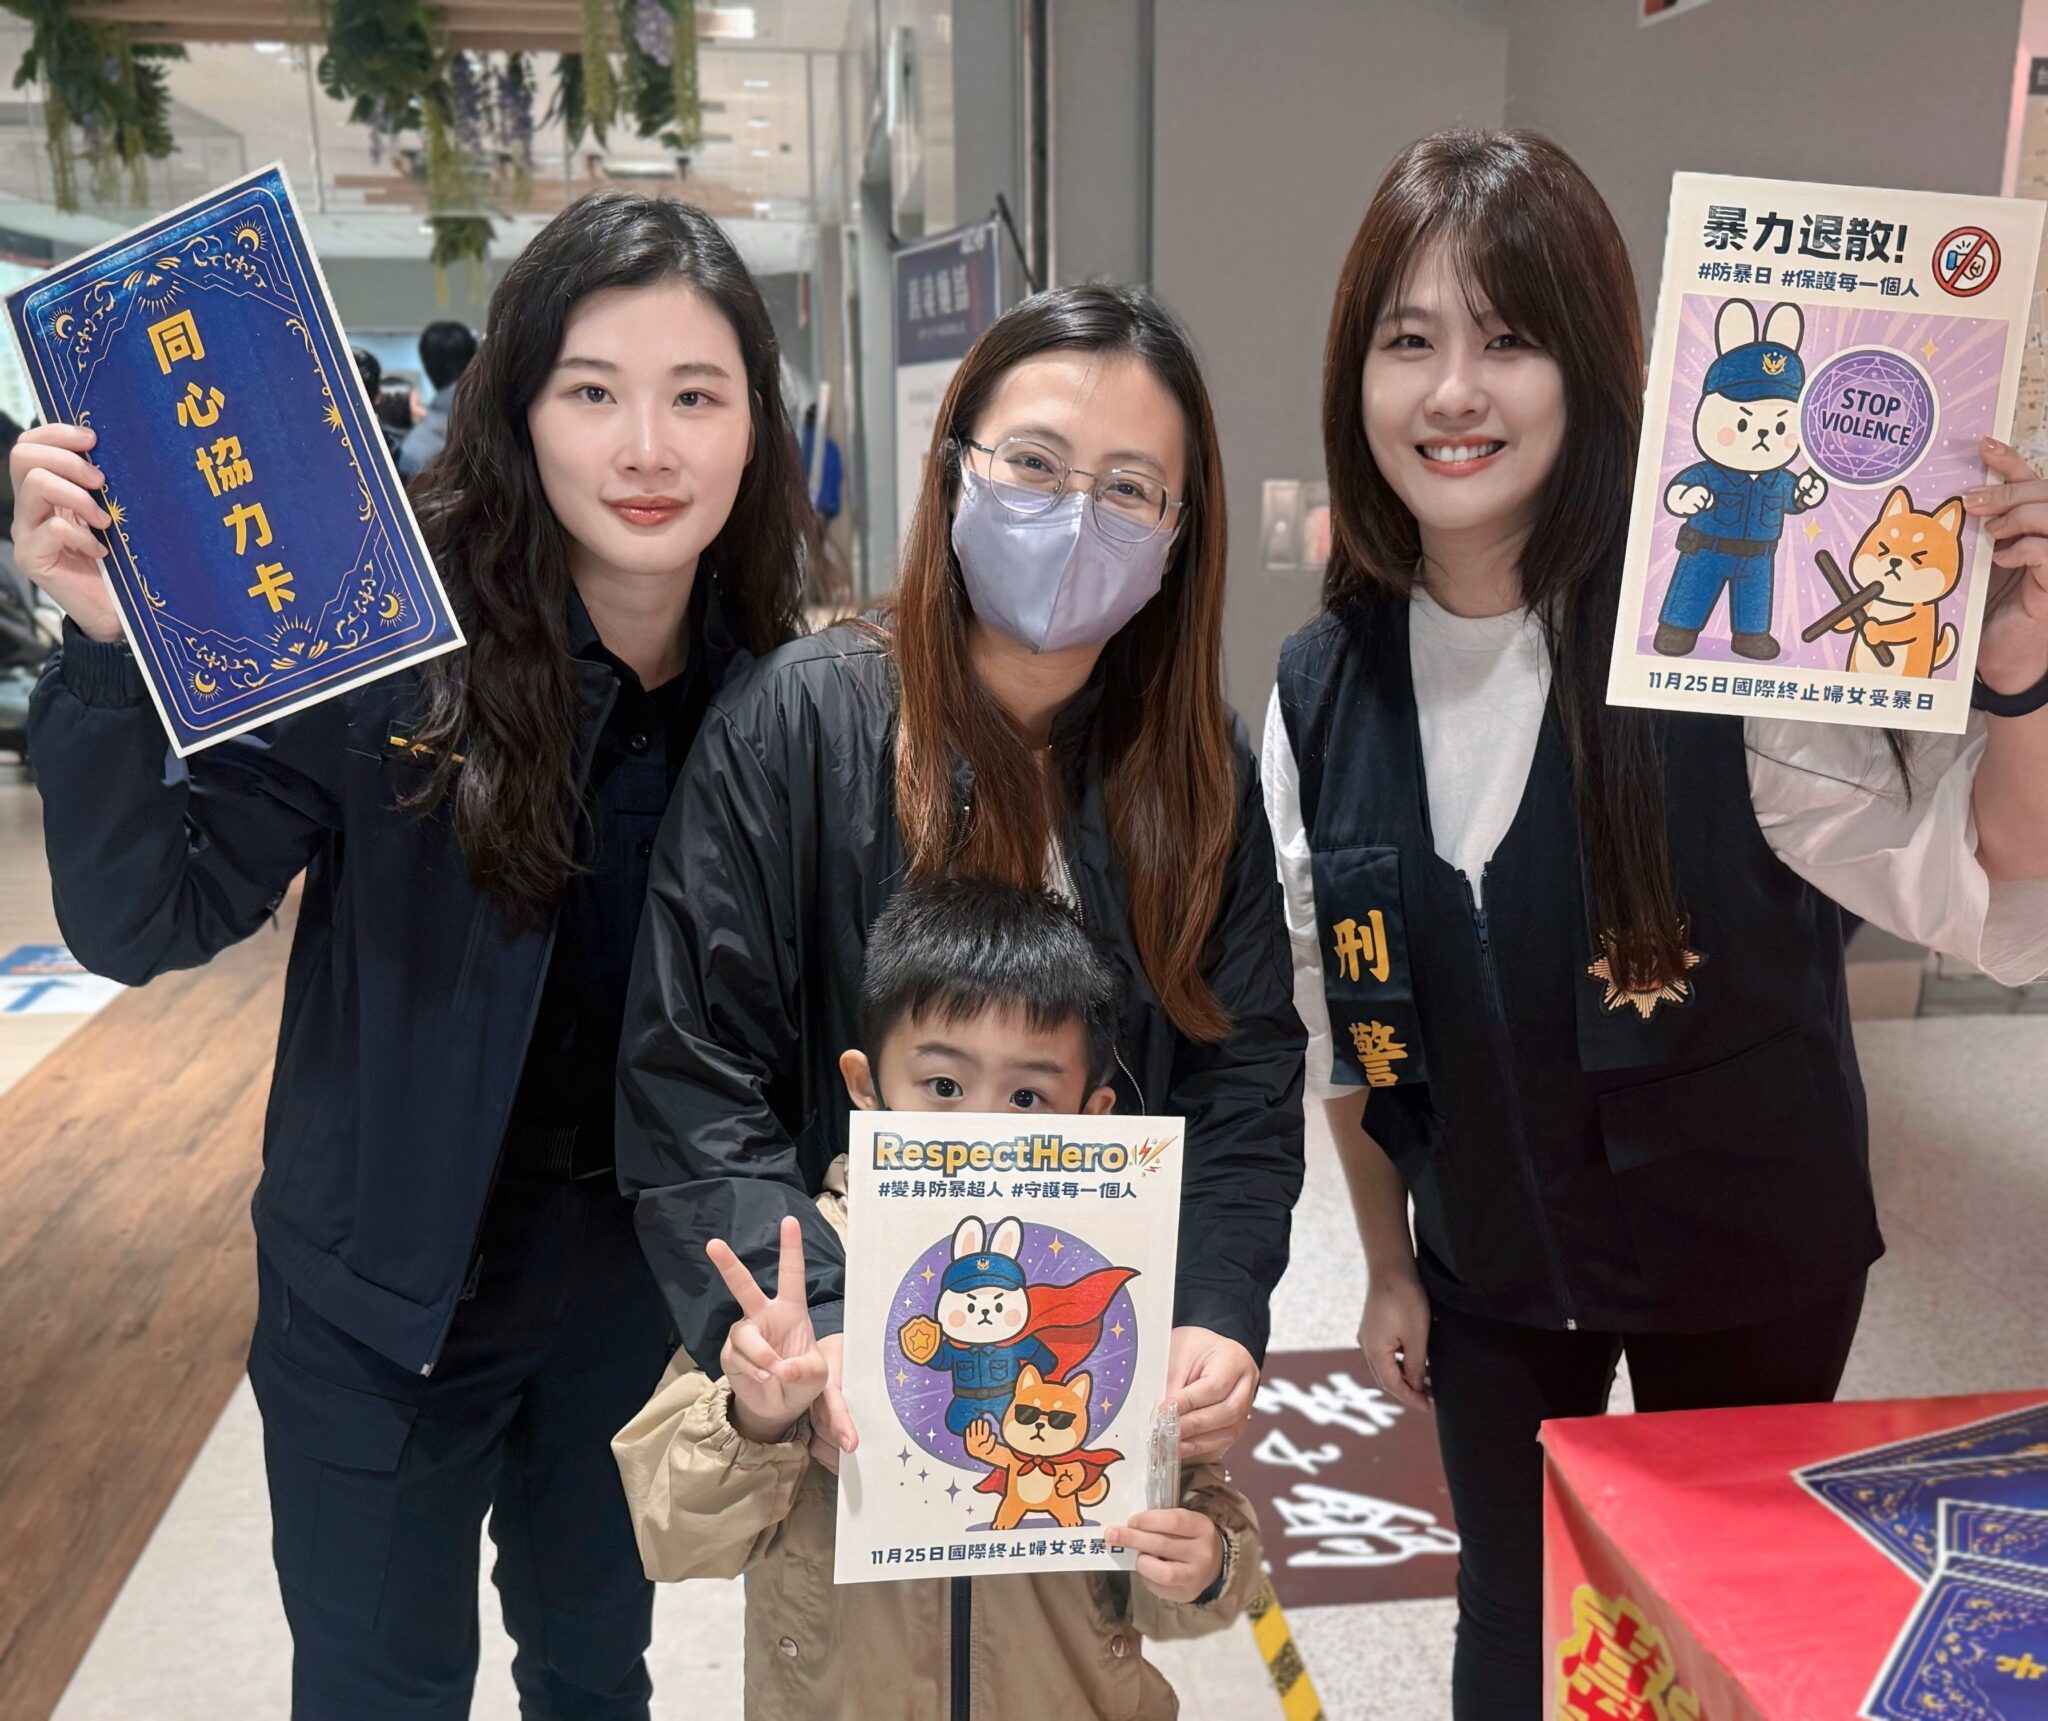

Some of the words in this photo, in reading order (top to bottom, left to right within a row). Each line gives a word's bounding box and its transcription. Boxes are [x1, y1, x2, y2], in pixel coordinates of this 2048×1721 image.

[1703, 205, 1908, 264] 暴力退散!
[1697, 262, 1773, 285] #防暴日
[1781, 269, 1920, 298] #保護每一個人
[1840, 387, 1901, 418] STOP
[1822, 410, 1913, 447] VIOLENCE
[147, 308, 296, 614] 同心協力卡
[1649, 671, 1935, 711] 11月25日國際終止婦女受暴日
[1333, 909, 1409, 1088] 刑警
[872, 1131, 1130, 1178] RespectHero
[878, 1180, 1003, 1198] #變身防暴超人
[1011, 1180, 1138, 1199] #守護每一個人
